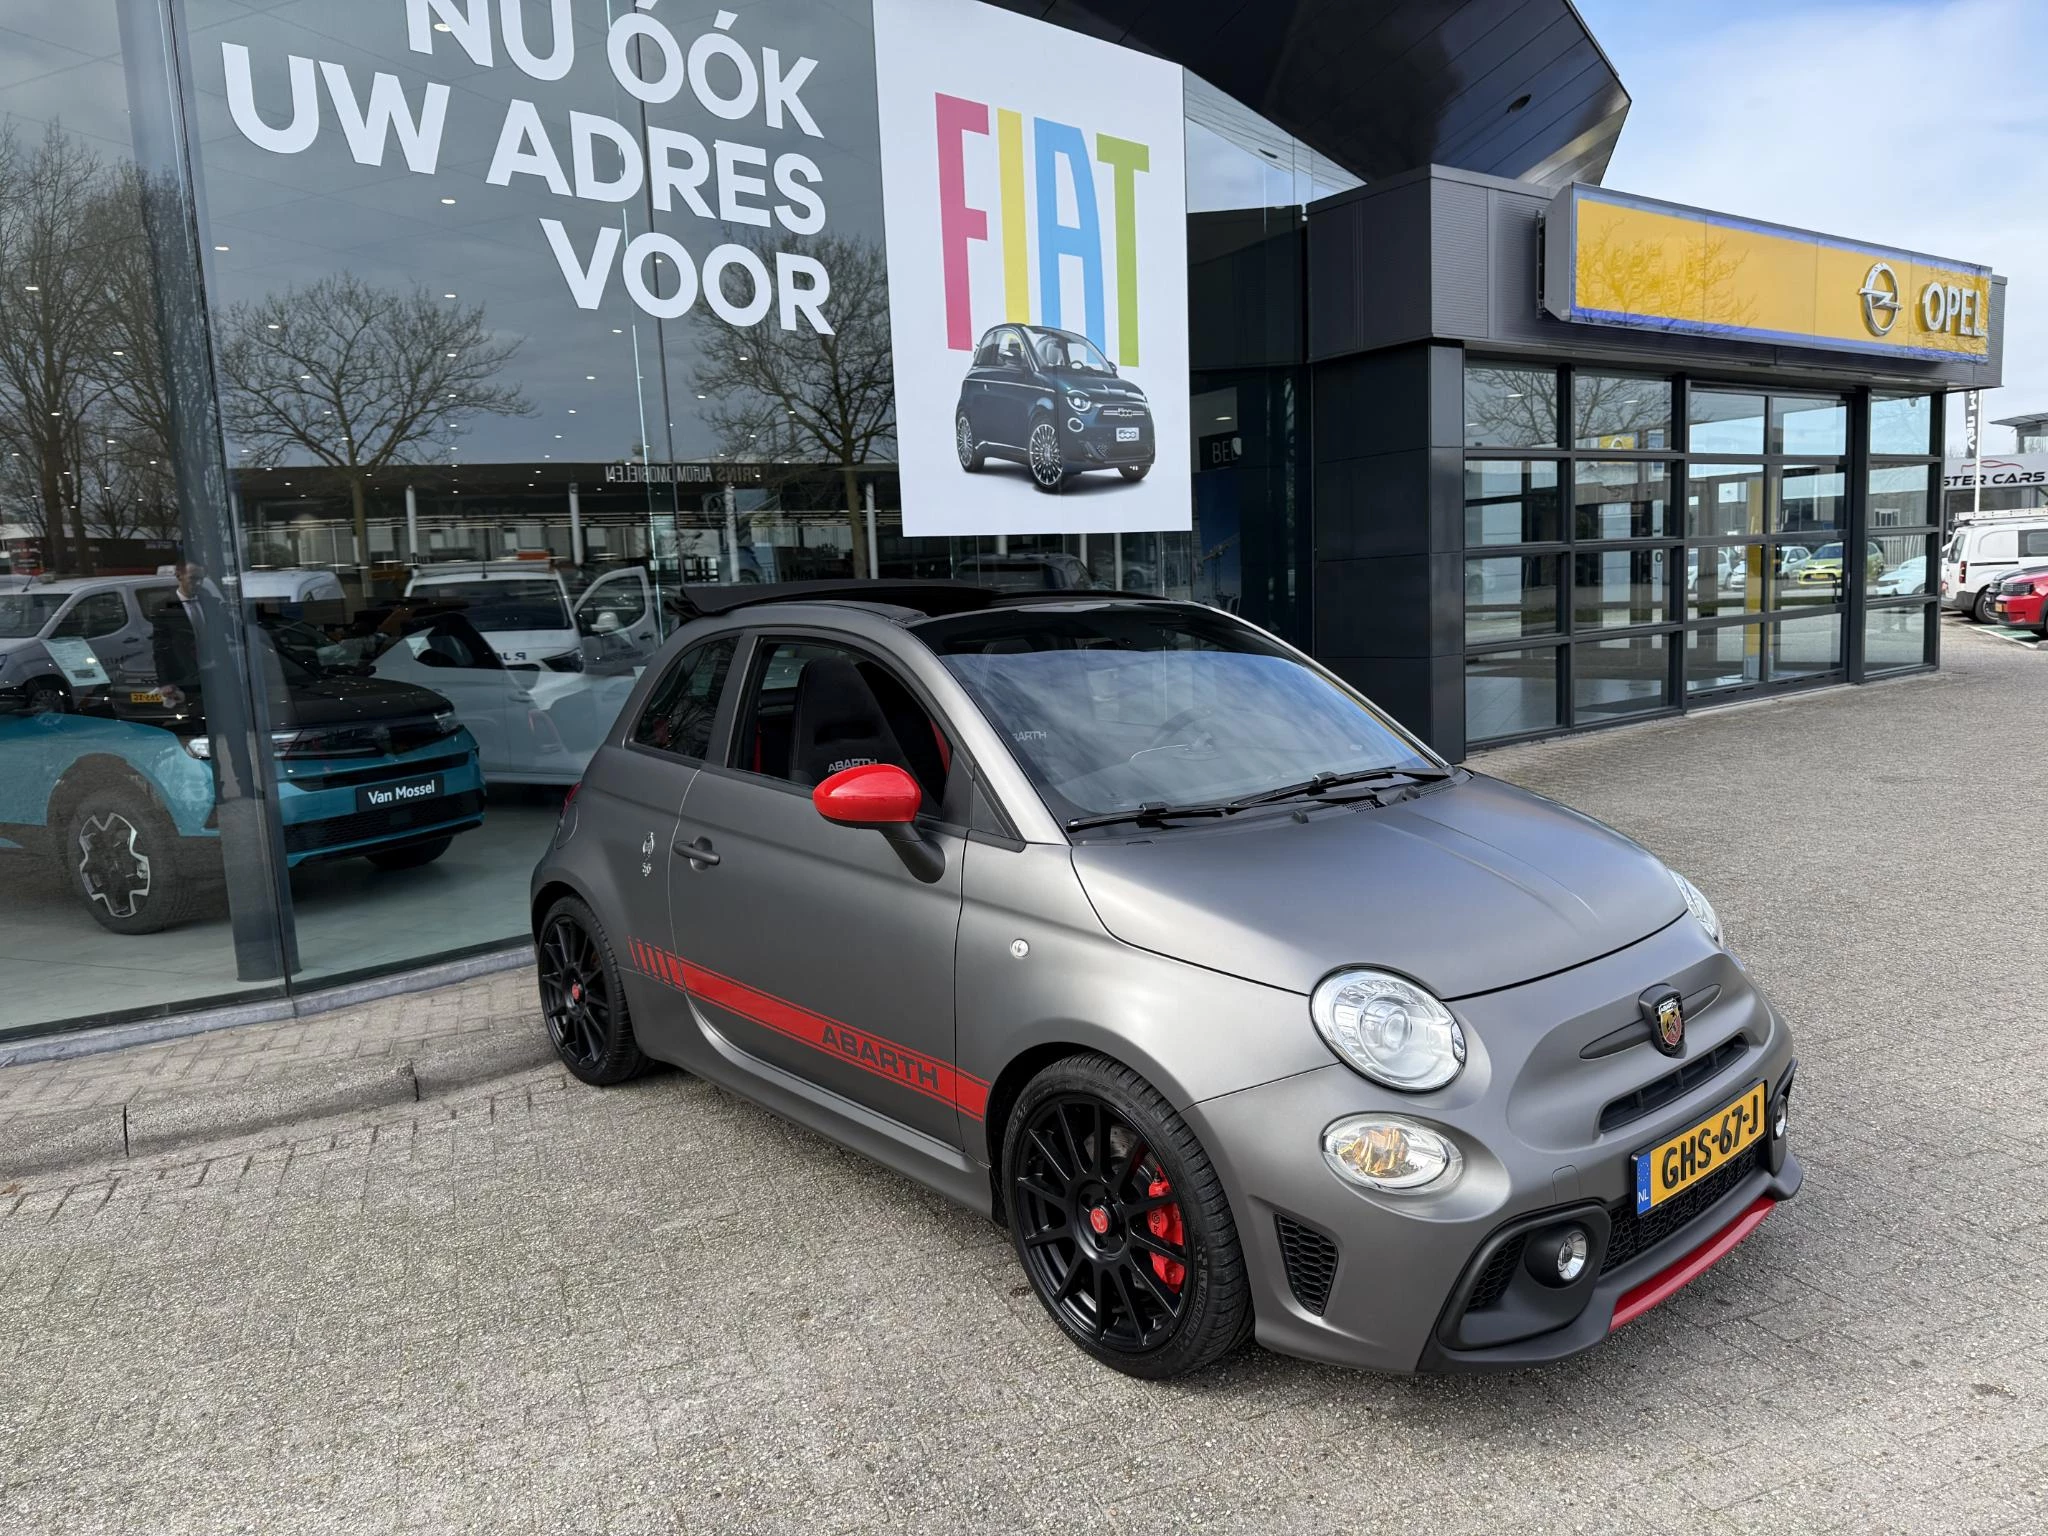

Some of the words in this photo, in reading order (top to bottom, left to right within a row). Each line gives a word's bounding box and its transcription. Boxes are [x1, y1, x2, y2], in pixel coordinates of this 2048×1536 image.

[405, 0, 575, 81] NU
[221, 42, 450, 175] UW
[485, 99, 826, 235] ADRES
[935, 92, 1150, 367] FIAT
[538, 218, 835, 335] VOOR
[1922, 281, 1985, 337] OPEL
[1992, 471, 2046, 484] CARS
[368, 790, 393, 805] Van
[395, 779, 435, 800] Mossel
[827, 758, 878, 773] ABARTH
[822, 1025, 939, 1090] ABARTH
[1662, 1094, 1759, 1190] GHS-67-J
[1638, 1188, 1649, 1204] NL
